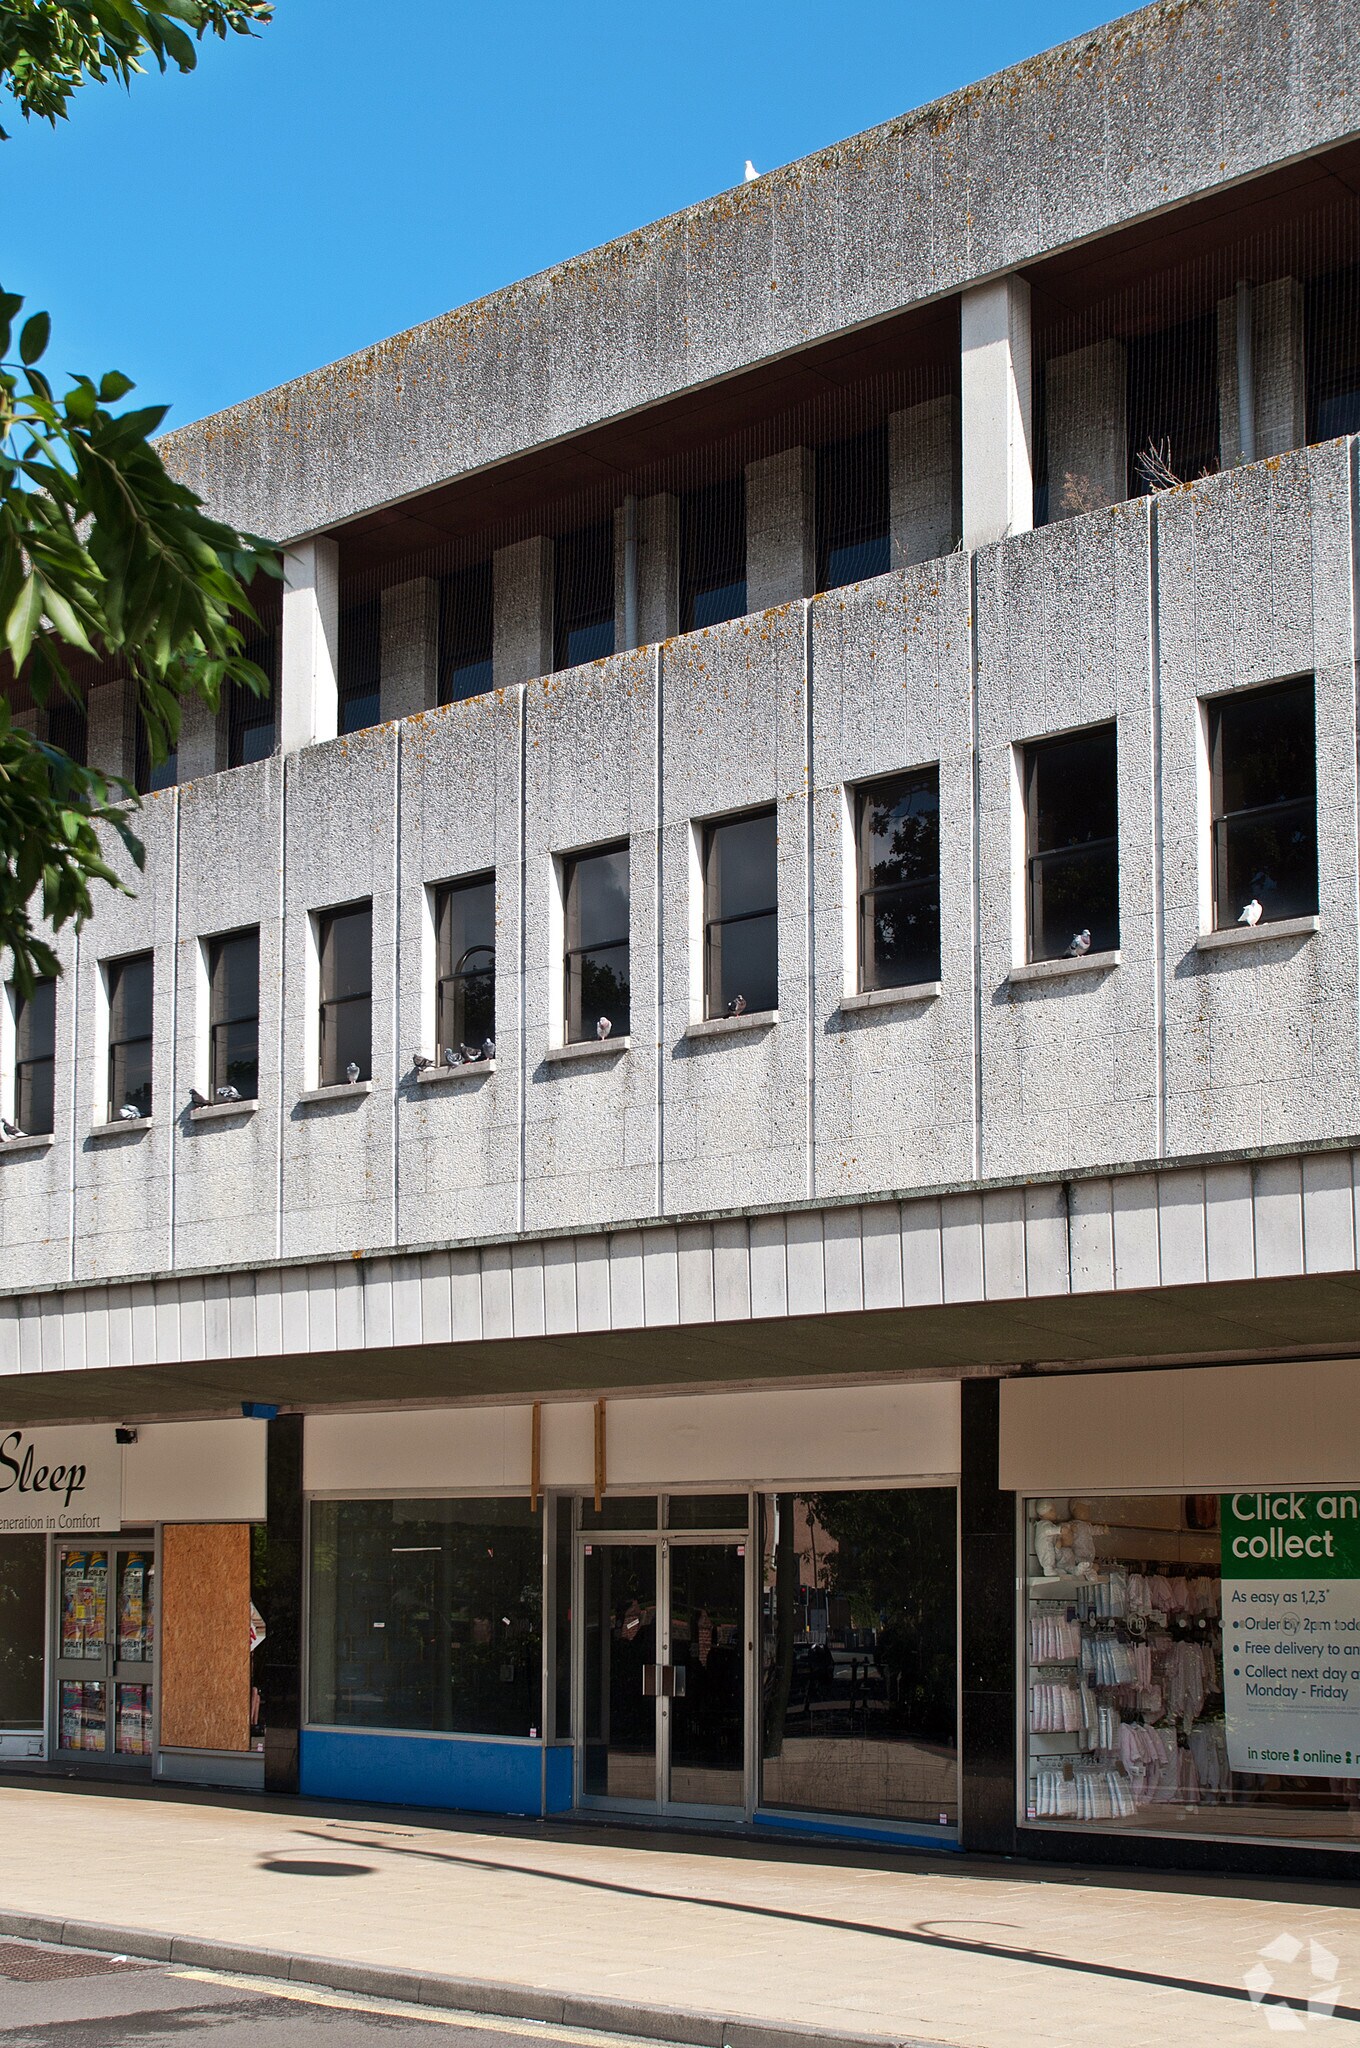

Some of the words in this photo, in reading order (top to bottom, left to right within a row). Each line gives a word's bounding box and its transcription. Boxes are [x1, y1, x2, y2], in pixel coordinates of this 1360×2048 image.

[0, 1430, 87, 1508] Sleep
[1231, 1493, 1306, 1521] Click
[1316, 1495, 1360, 1519] an
[46, 1515, 55, 1529] in
[58, 1513, 101, 1529] Comfort
[1232, 1526, 1335, 1559] collect
[1231, 1590, 1247, 1603] As
[1250, 1592, 1280, 1606] easy
[1283, 1592, 1298, 1603] as
[1245, 1616, 1281, 1631] Order
[1284, 1617, 1300, 1634] by
[1245, 1640, 1271, 1654] Free
[1274, 1641, 1325, 1658] delivery
[1328, 1643, 1340, 1655] to
[1245, 1664, 1288, 1679] Collect
[1291, 1666, 1319, 1680] next
[1322, 1666, 1347, 1683] day
[1245, 1682, 1299, 1700] Monday
[1310, 1684, 1349, 1702] Friday
[1247, 1747, 1258, 1760] in
[1261, 1748, 1290, 1761] store
[1303, 1750, 1342, 1764] online
